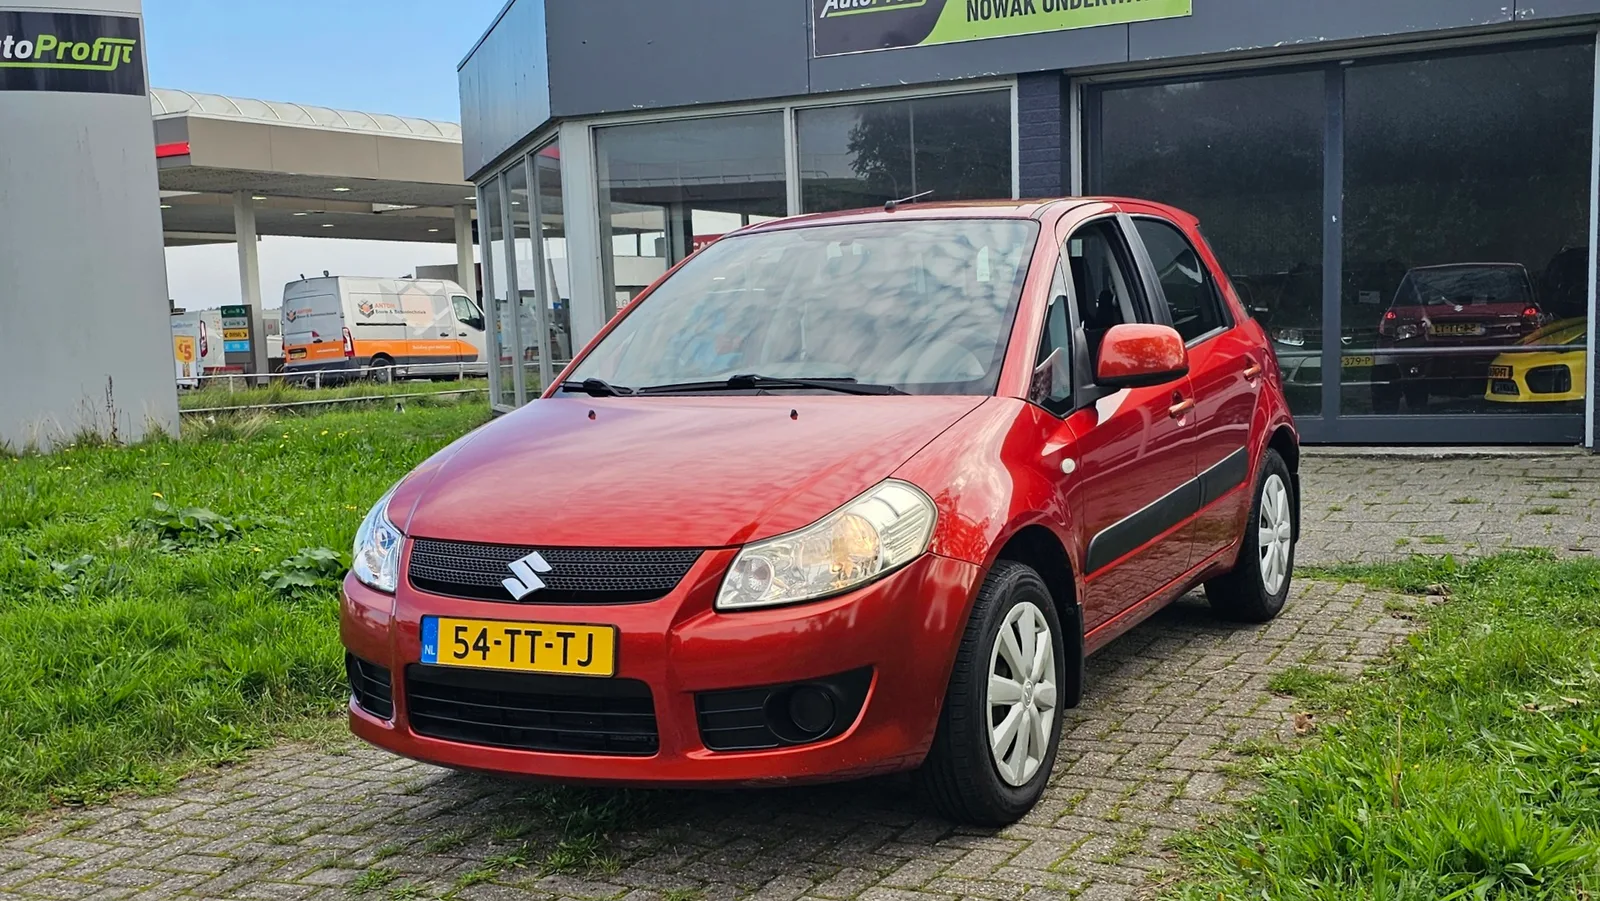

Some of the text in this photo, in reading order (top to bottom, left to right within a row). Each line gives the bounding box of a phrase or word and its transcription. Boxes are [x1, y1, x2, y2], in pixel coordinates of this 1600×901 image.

[966, 0, 1036, 22] NOWAK
[0, 34, 136, 71] toProfijt
[424, 644, 436, 655] NL
[453, 626, 593, 667] 54-TT-TJ
